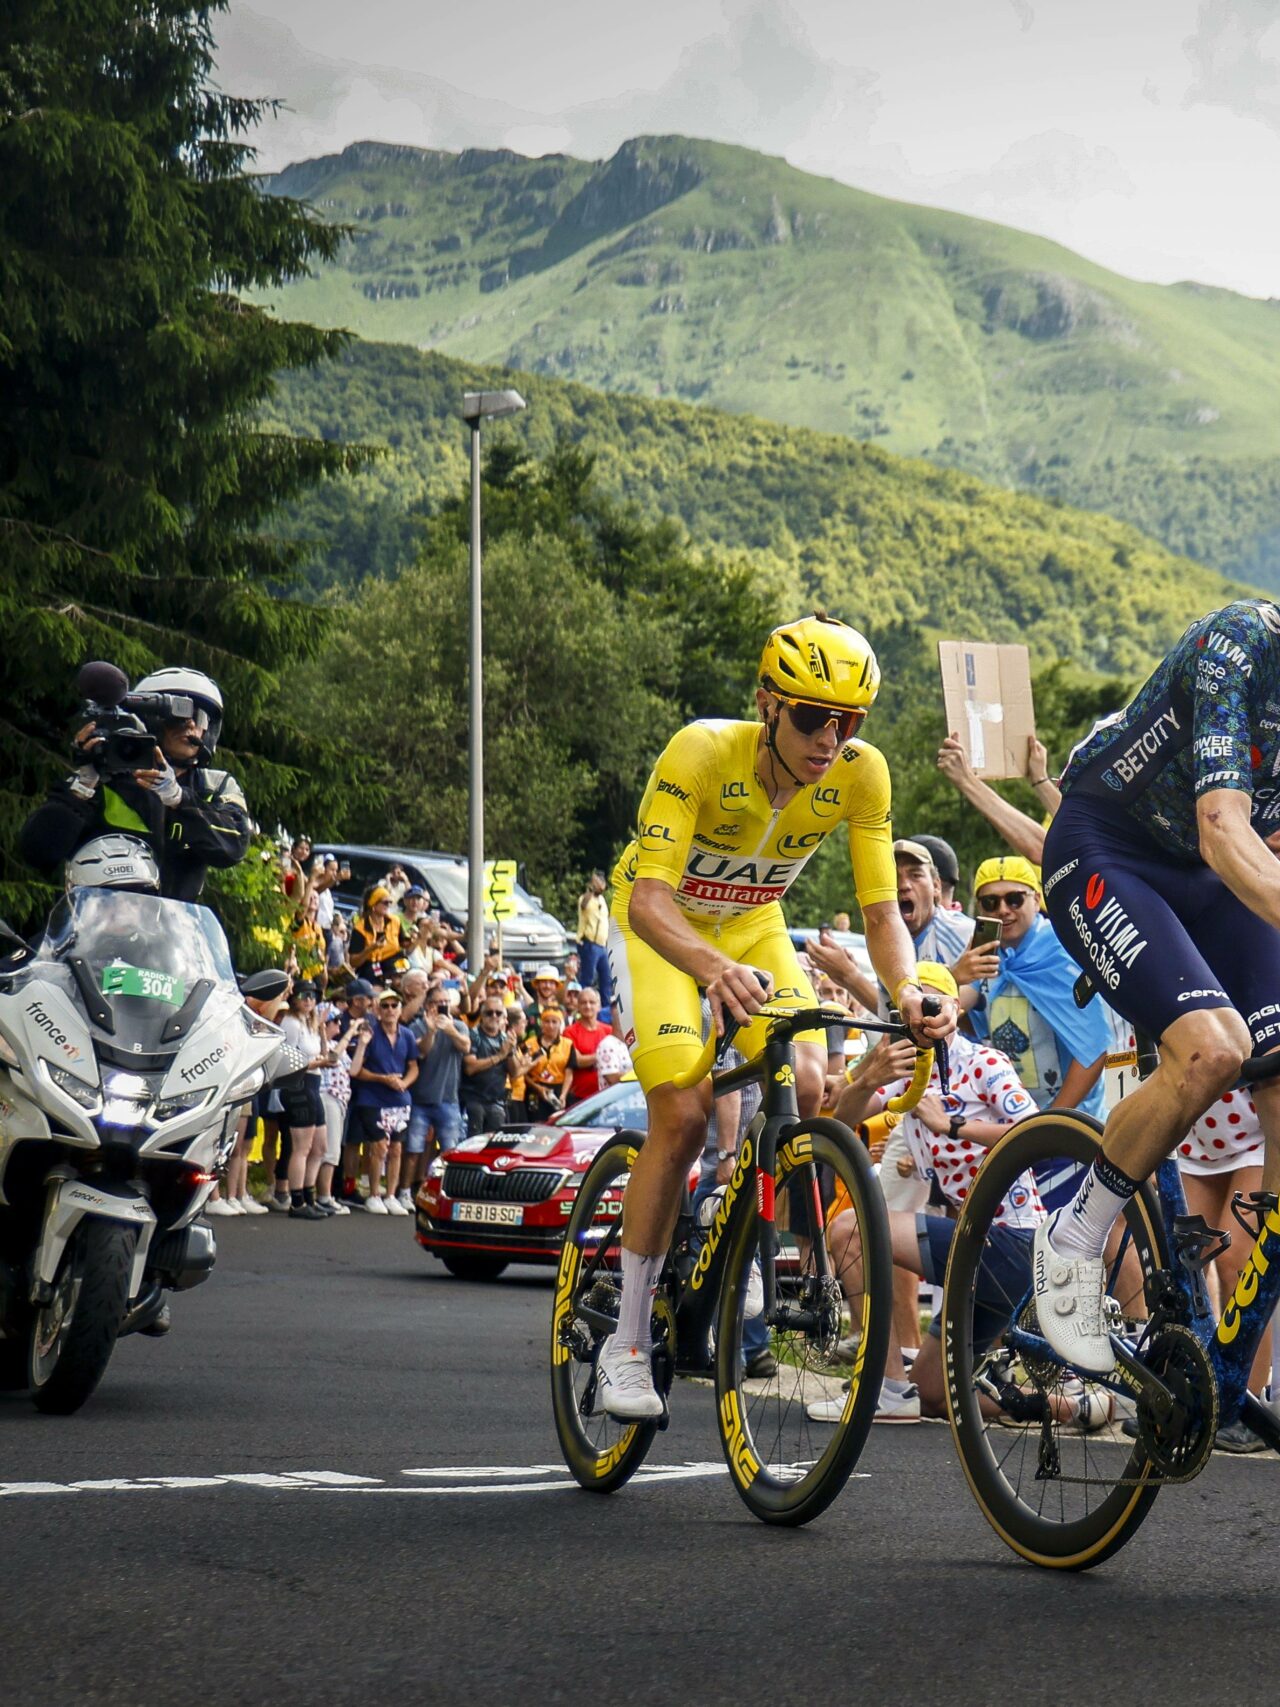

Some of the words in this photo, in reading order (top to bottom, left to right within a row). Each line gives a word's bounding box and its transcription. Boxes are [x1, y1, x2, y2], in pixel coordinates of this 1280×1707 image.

[807, 642, 825, 682] MET
[1207, 631, 1252, 678] VISMA
[1113, 707, 1181, 784] BETCITY
[722, 782, 750, 798] LCL
[814, 787, 841, 805] LCL
[640, 822, 676, 843] LCL
[107, 865, 134, 875] SHOEI
[687, 854, 797, 884] UAE
[680, 879, 786, 903] Emirates
[1068, 895, 1093, 948] lease
[1095, 944, 1121, 990] bike
[1095, 896, 1148, 969] VISMA
[138, 970, 179, 985] RADIO-TV
[142, 977, 174, 999] 304
[774, 987, 809, 1000] CL
[1177, 989, 1230, 1002] cerv
[133, 1043, 142, 1053] B
[1117, 1071, 1124, 1100] 1
[692, 1138, 753, 1291] COLNAGO
[1036, 1251, 1049, 1297] nimbl
[946, 1320, 963, 1427] RESERVE
[1113, 1360, 1145, 1395] SRA
